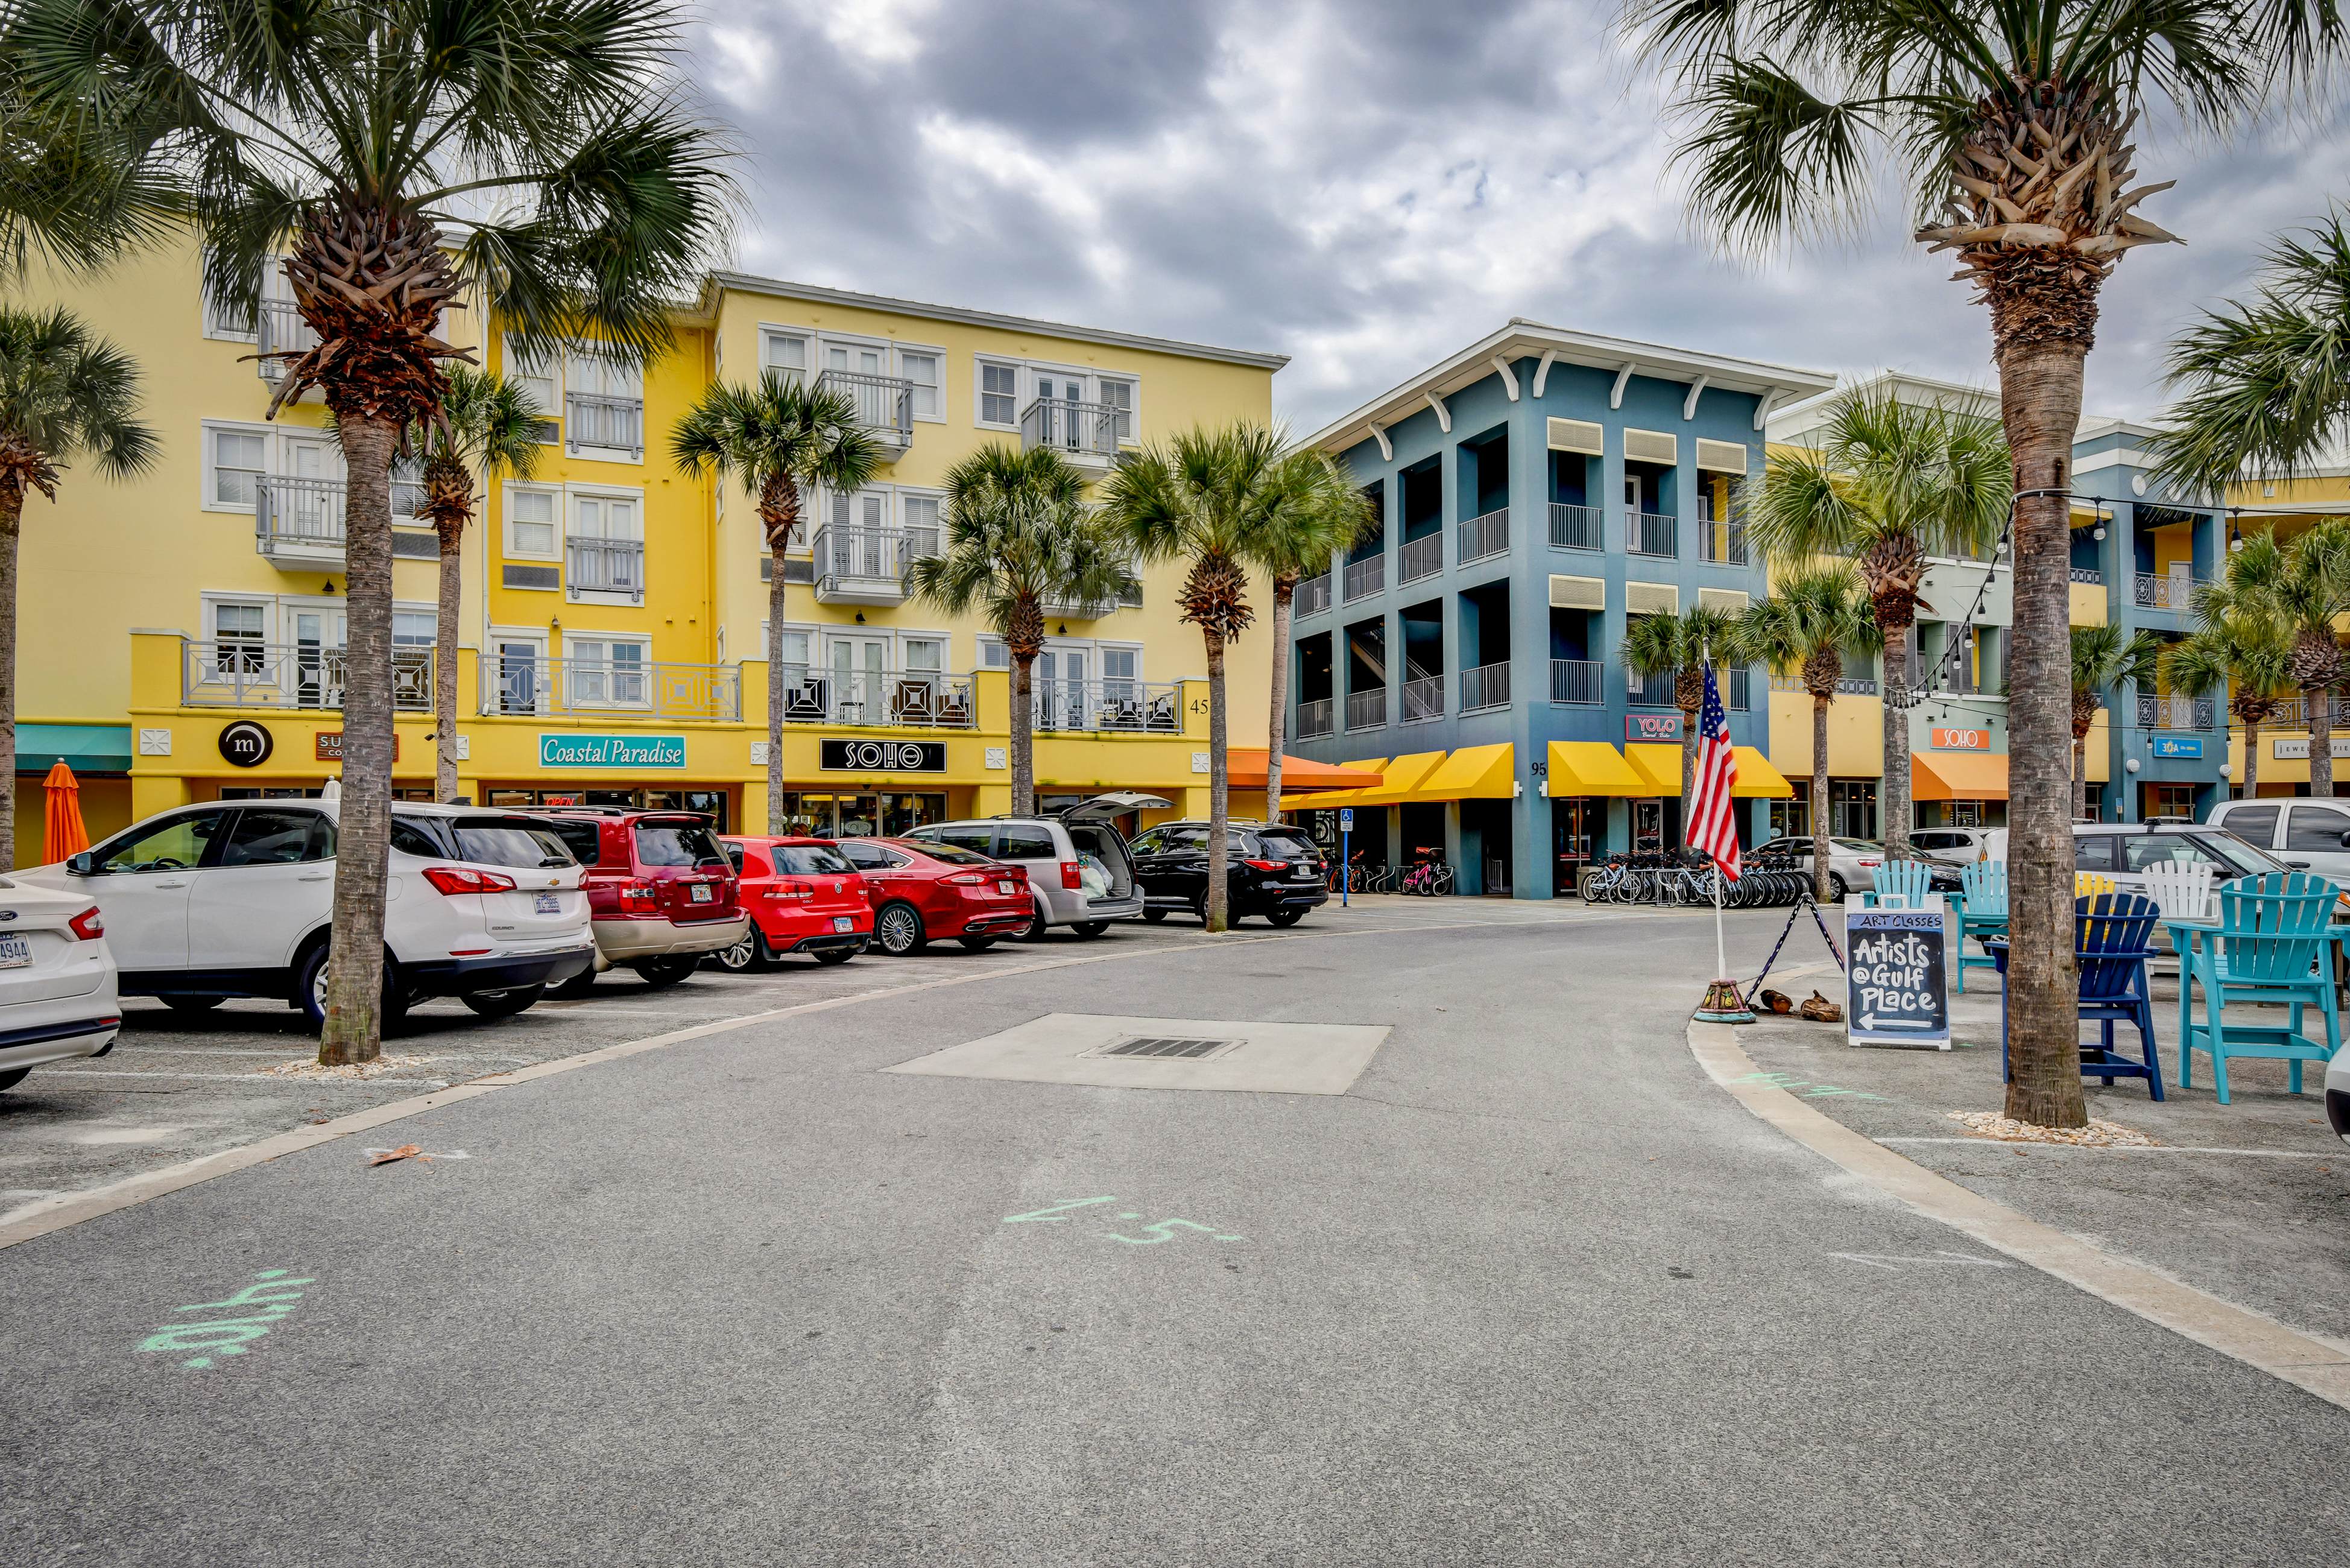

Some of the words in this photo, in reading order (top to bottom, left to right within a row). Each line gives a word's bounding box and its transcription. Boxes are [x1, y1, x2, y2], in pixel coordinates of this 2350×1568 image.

[1190, 699, 1208, 714] 45
[1638, 718, 1676, 733] YOLO
[1944, 729, 1978, 747] SOHO
[543, 739, 608, 762] Coastal
[611, 740, 682, 763] Paradise
[845, 742, 923, 768] SOHO
[1531, 762, 1547, 776] 95
[546, 797, 575, 806] OPEN
[1860, 915, 1890, 926] ART
[1853, 932, 1930, 968] Artists
